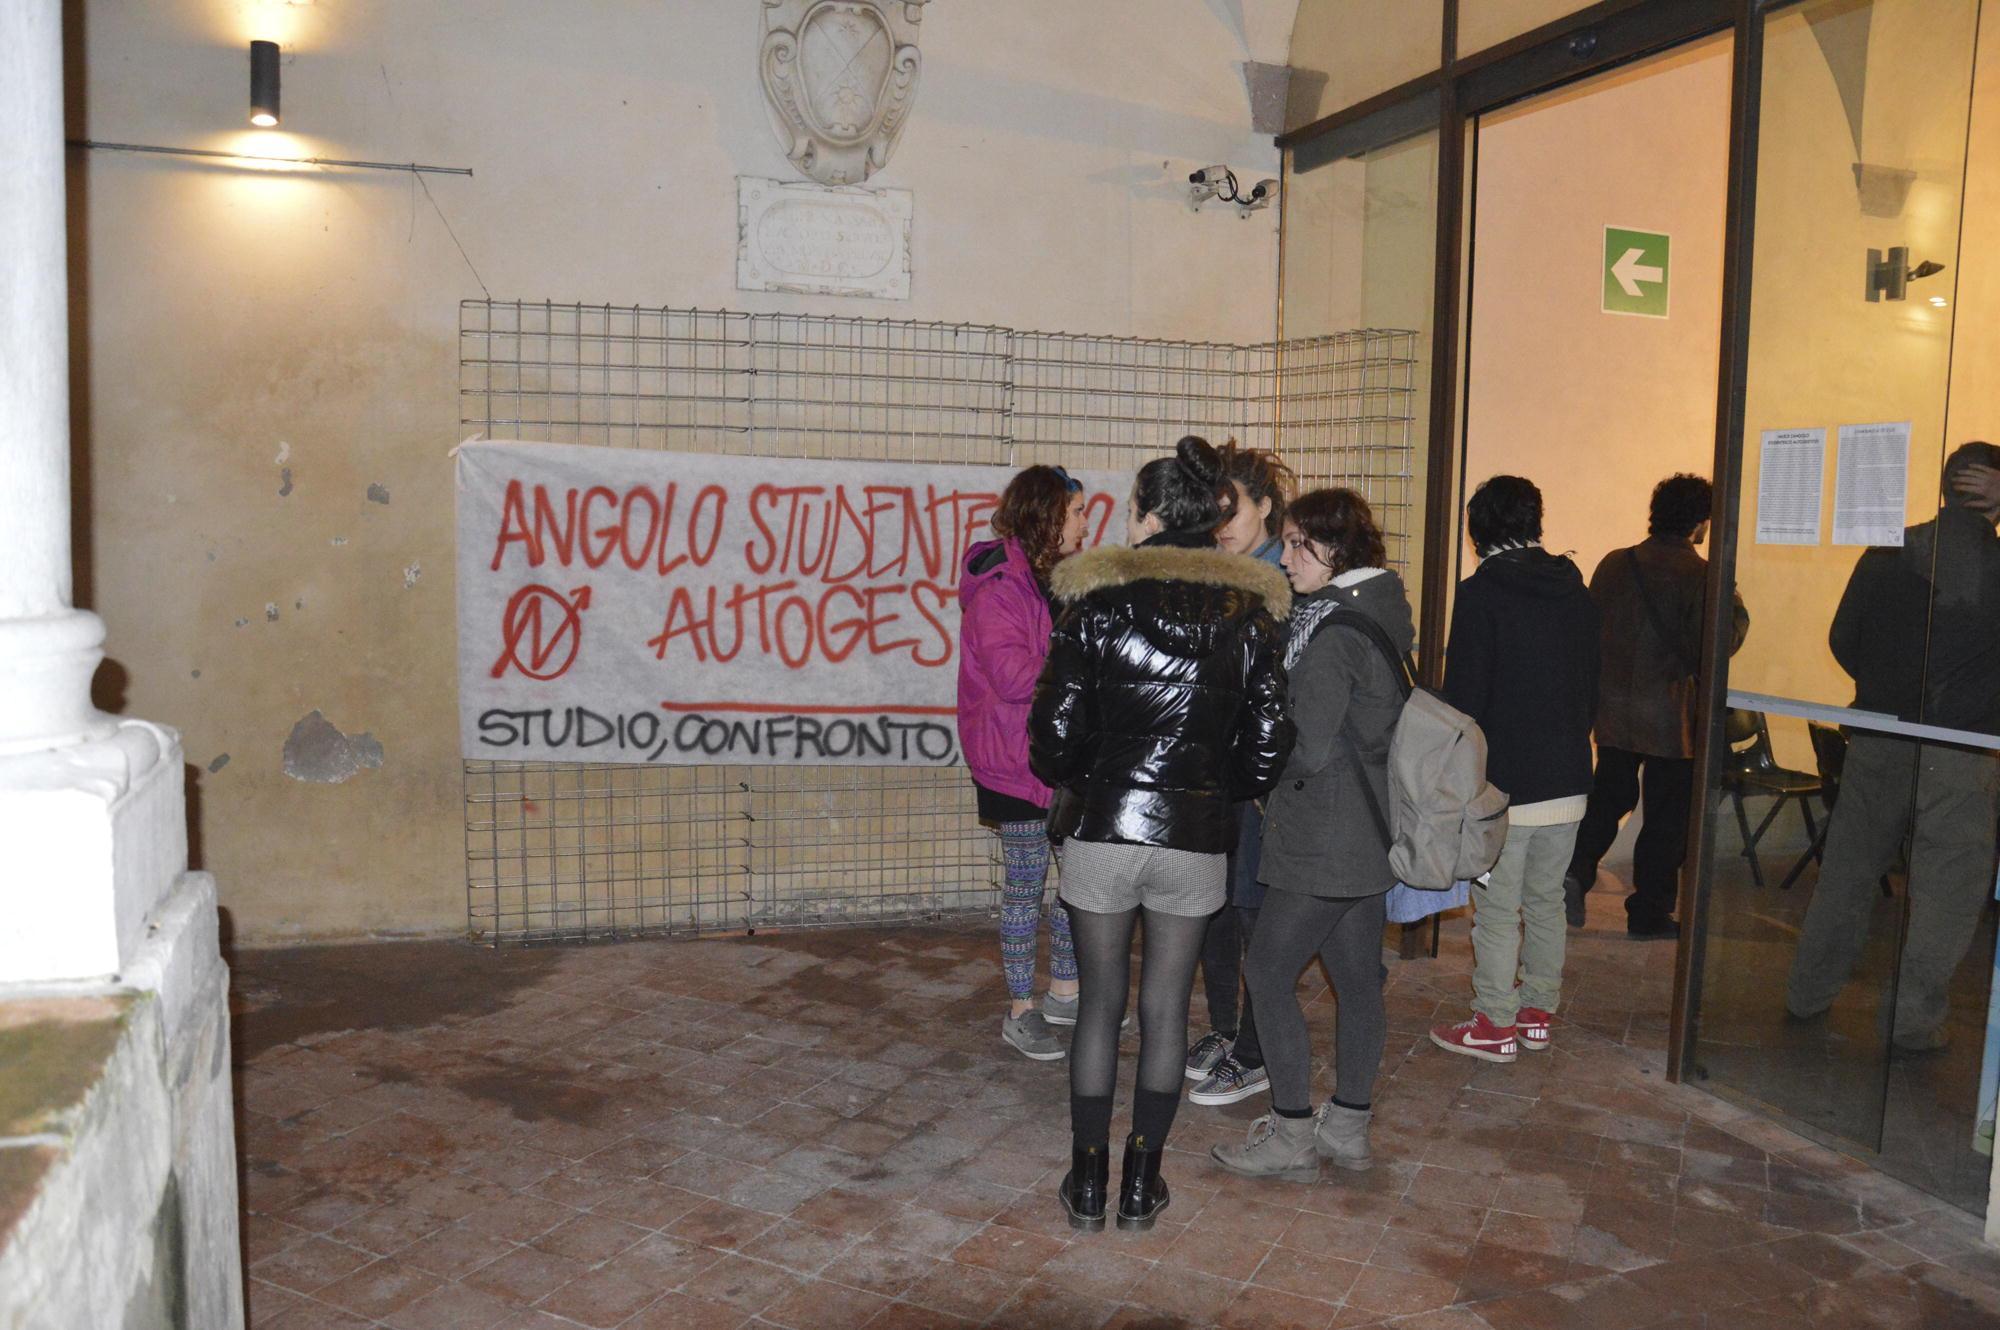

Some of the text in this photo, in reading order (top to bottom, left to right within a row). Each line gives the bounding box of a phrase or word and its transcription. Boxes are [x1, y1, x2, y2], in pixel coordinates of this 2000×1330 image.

[491, 479, 729, 577] ANGOLO
[647, 579, 960, 668] AUTOGES
[1527, 1028, 1549, 1039] NIK
